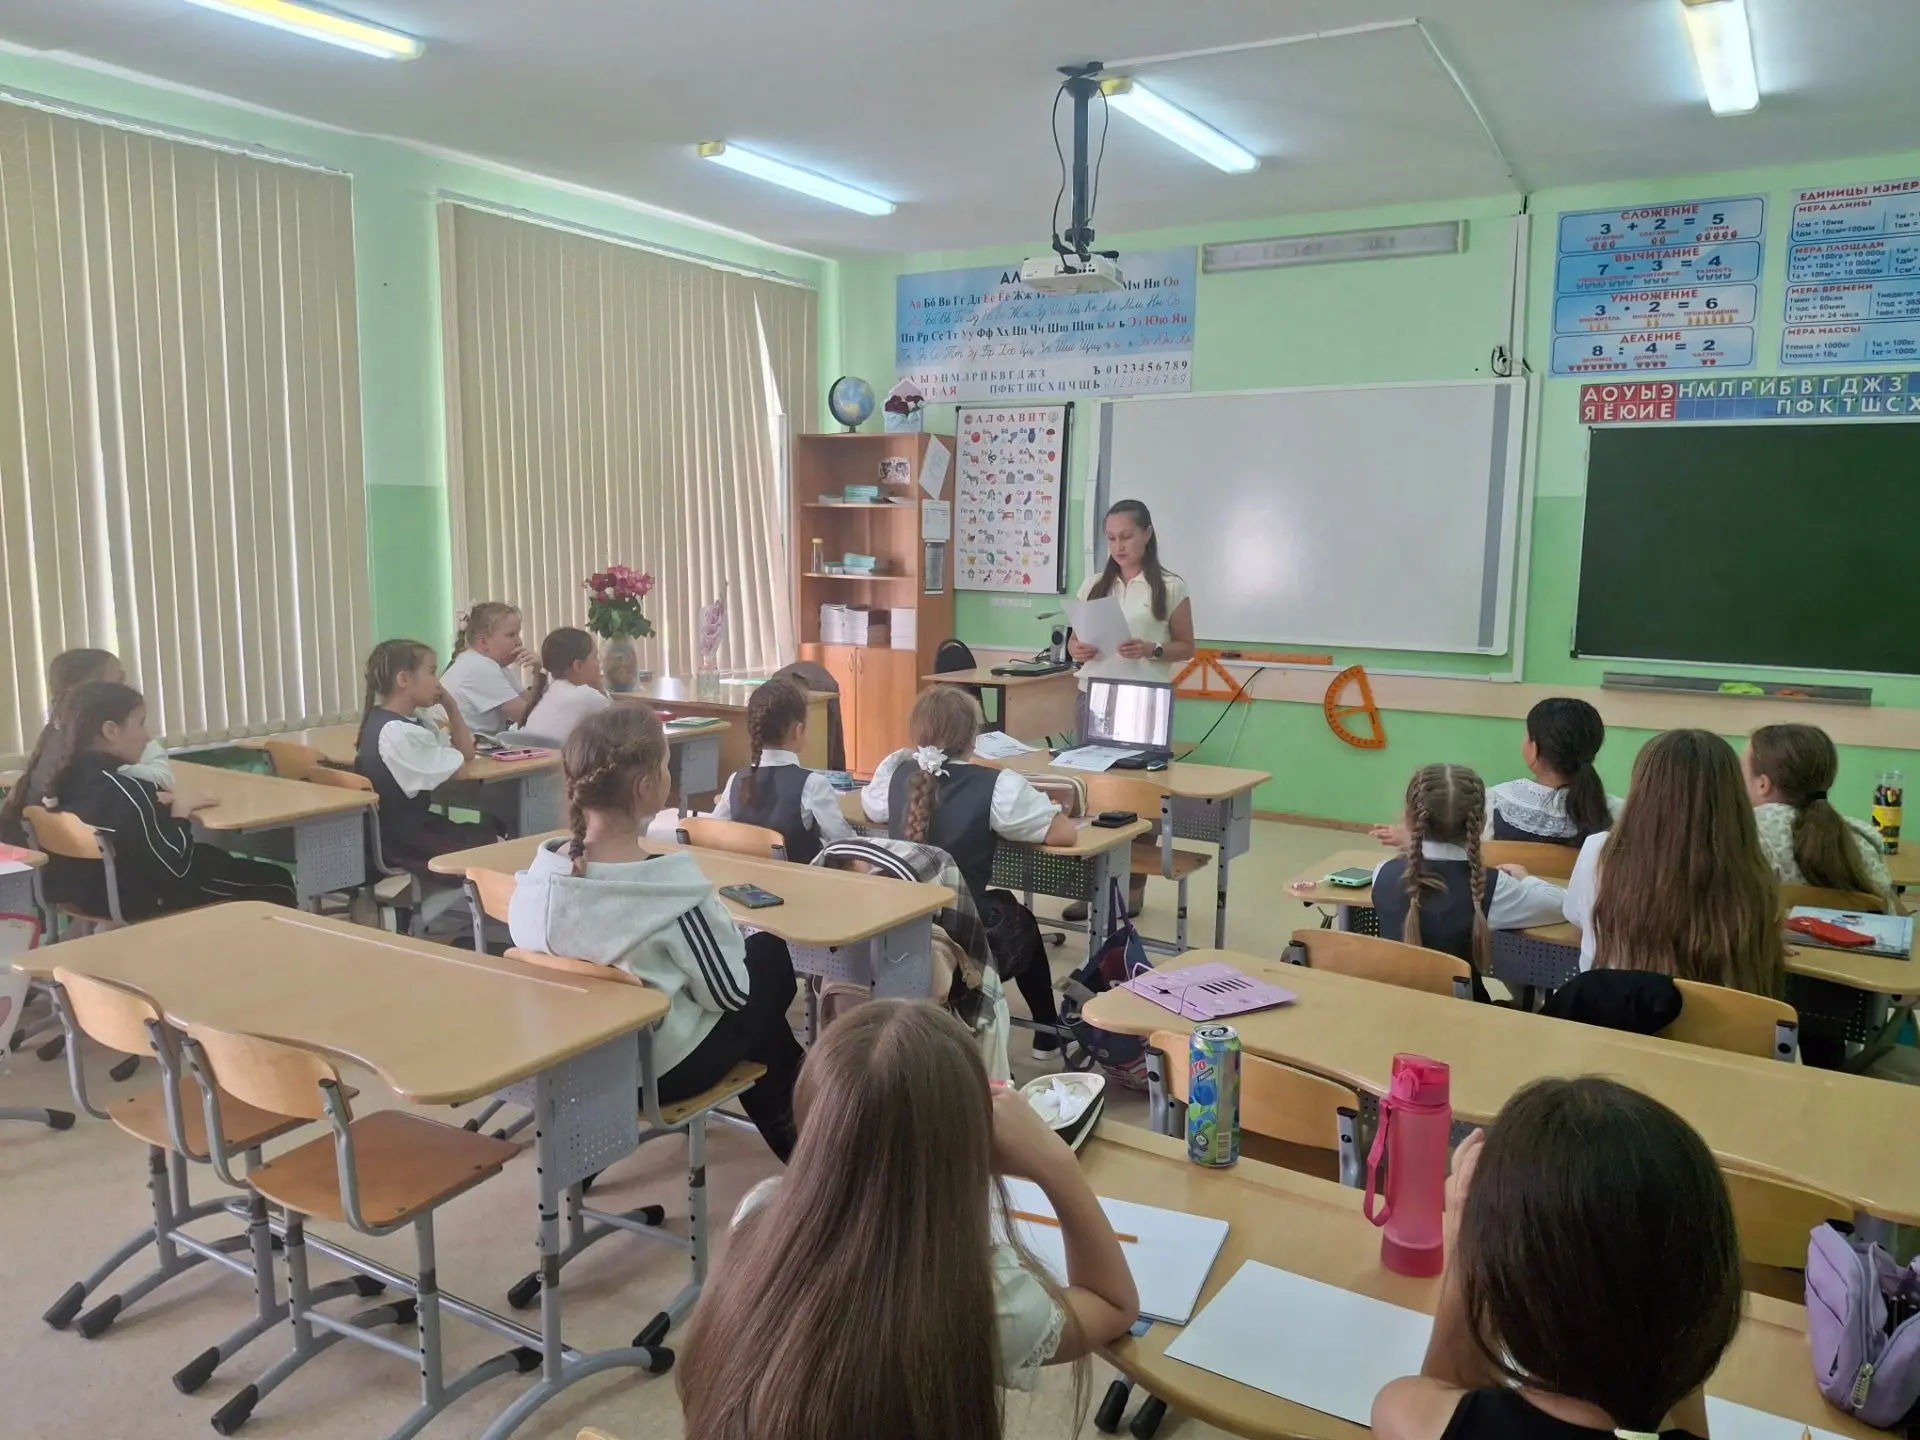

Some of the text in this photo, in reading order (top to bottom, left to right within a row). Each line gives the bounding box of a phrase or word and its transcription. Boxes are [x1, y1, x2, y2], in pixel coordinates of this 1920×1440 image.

[1799, 187, 1868, 201] ЕДИНИЦЫ
[1620, 204, 1700, 220] СЛОЖЕНИЕ
[1798, 200, 1872, 213] МЕРА ДЛИНЫ
[1600, 224, 1612, 235] 3
[1654, 218, 1666, 230] 2
[1712, 213, 1725, 225] 5
[1614, 248, 1700, 262] ВЫЧИТАНИЕ
[1598, 264, 1610, 276] 7
[1652, 260, 1663, 272] 3
[1708, 255, 1722, 266] 4
[1610, 289, 1699, 303] УМНОЖЕНИЕ
[1791, 284, 1873, 295] МЕРА ВРЕМЕНИ
[1595, 305, 1606, 316] 3
[1648, 302, 1661, 312] 2
[1705, 298, 1718, 310] 6
[1620, 332, 1682, 344] ДЕЛЕНИЕ
[1788, 326, 1860, 336] МЕРА МАССЫ
[1592, 345, 1604, 356] 8
[1644, 342, 1657, 354] 4
[1702, 340, 1716, 352] 2
[976, 412, 1046, 424] АЛФАВИТ
